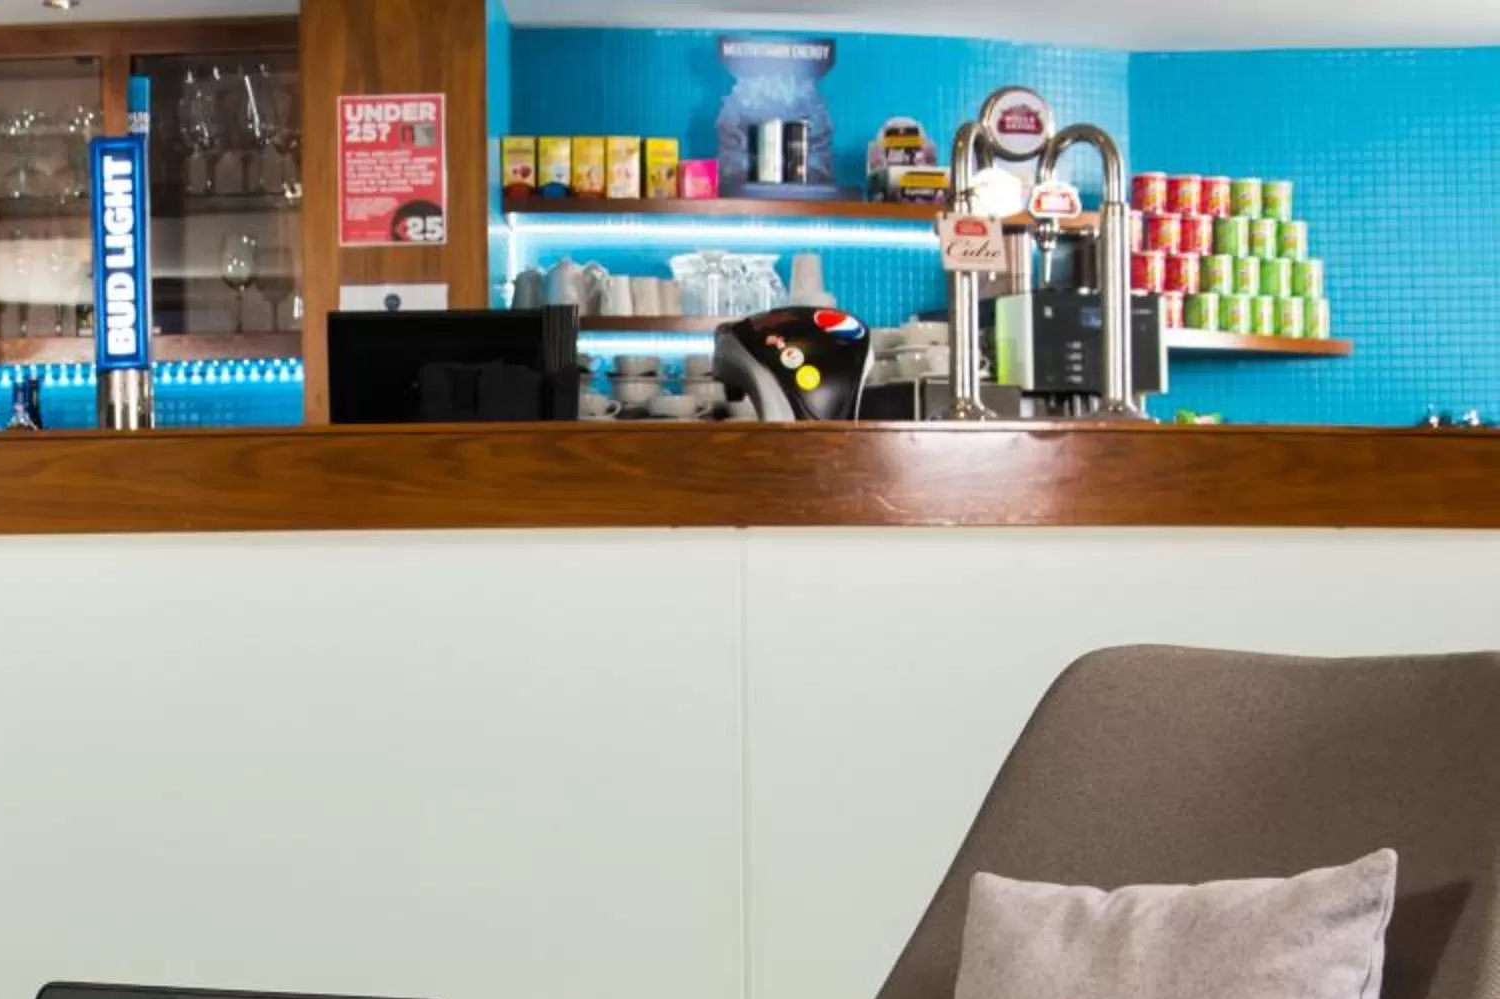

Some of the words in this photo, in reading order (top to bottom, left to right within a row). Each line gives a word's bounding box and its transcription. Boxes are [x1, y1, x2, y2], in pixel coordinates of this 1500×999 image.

[344, 102, 436, 121] UNDER
[345, 120, 391, 143] 25?
[103, 155, 135, 269] LIGHT
[406, 215, 444, 241] 25
[106, 272, 137, 356] BUD
